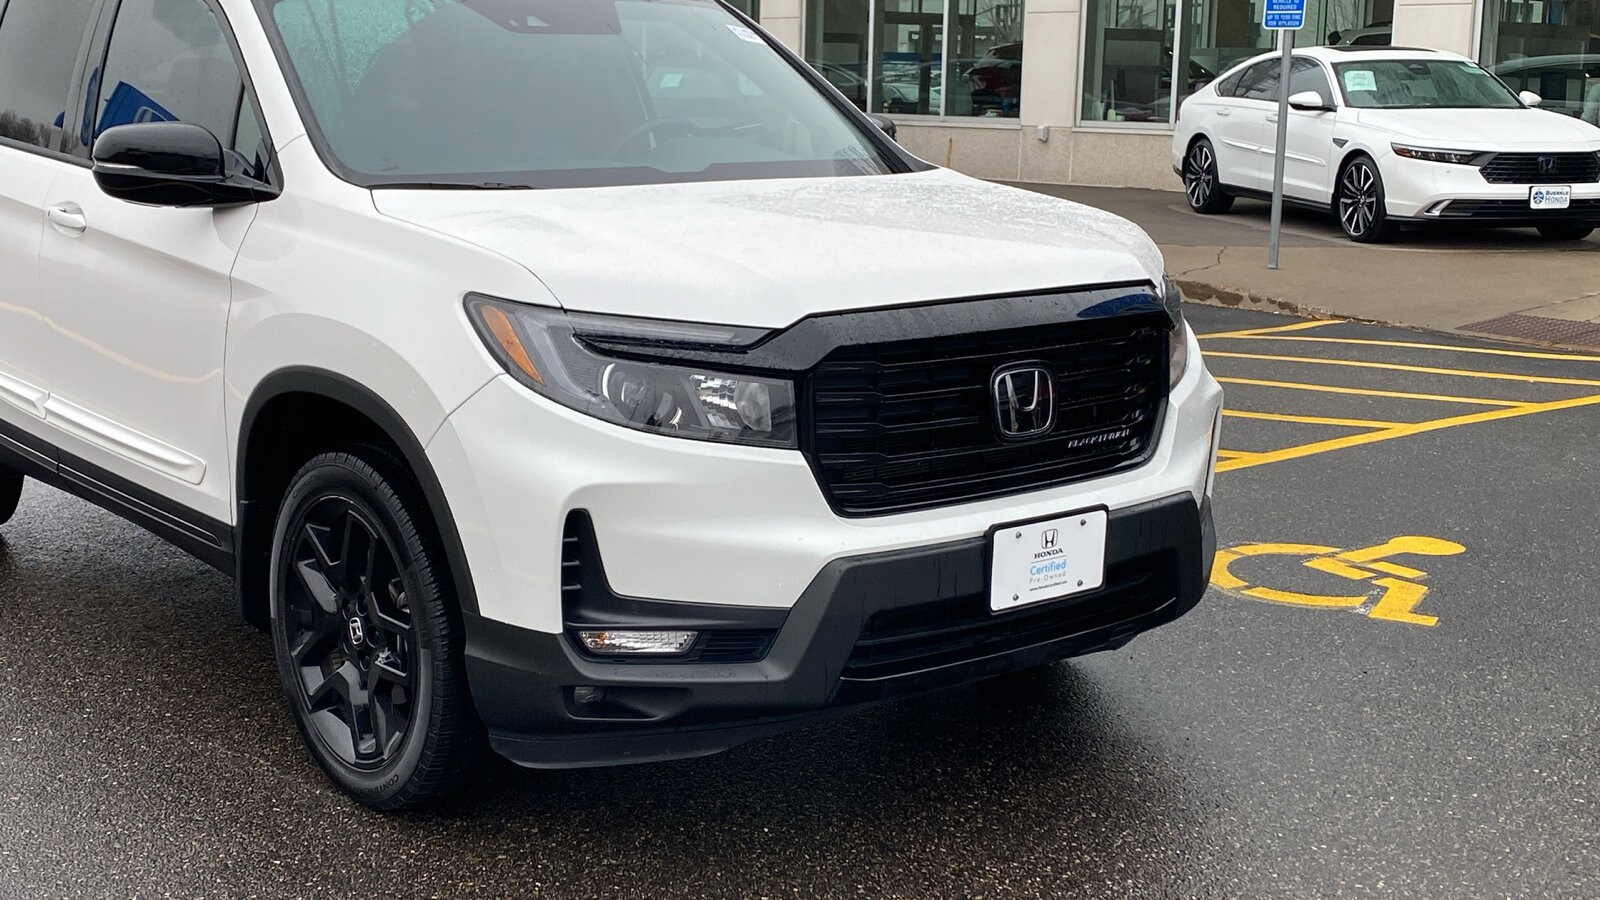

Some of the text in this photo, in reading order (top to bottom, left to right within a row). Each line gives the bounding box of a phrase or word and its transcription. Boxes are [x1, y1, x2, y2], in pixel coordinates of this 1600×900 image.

[1546, 196, 1568, 204] HONDA
[1034, 548, 1063, 558] HONDA
[1030, 560, 1066, 575] Certified
